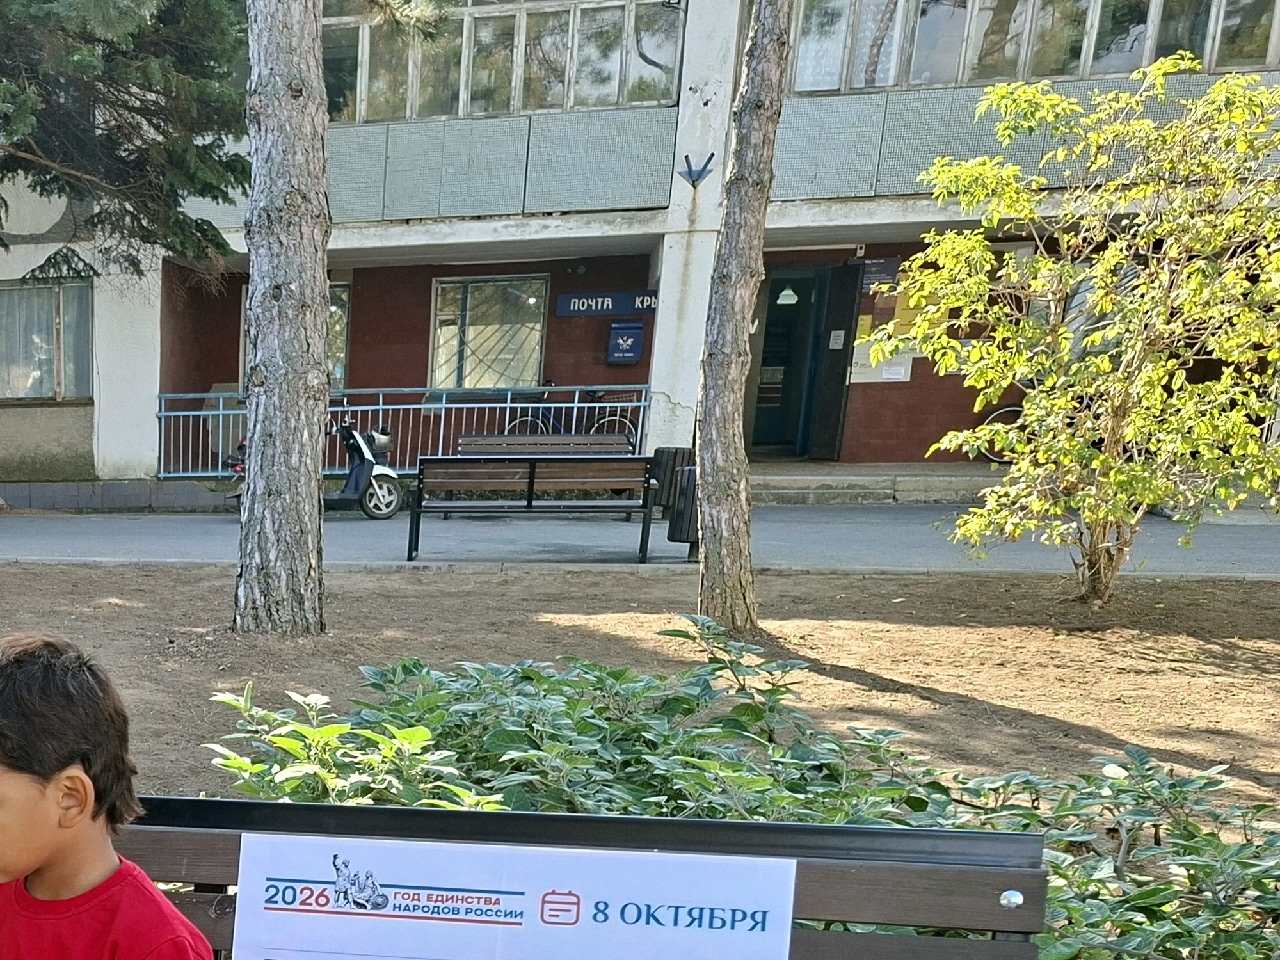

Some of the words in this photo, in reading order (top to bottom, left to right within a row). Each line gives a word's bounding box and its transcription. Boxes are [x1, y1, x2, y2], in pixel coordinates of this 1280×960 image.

[570, 297, 613, 311] ПОЧТА
[264, 884, 331, 908] 2026
[393, 891, 421, 904] ГОД
[426, 893, 501, 907] ЕДИНСТВА
[392, 903, 461, 916] НАРОДОВ
[465, 907, 524, 919] РОССИИ
[592, 900, 610, 924] 8
[619, 901, 770, 932] ОКТЯБРЯ
